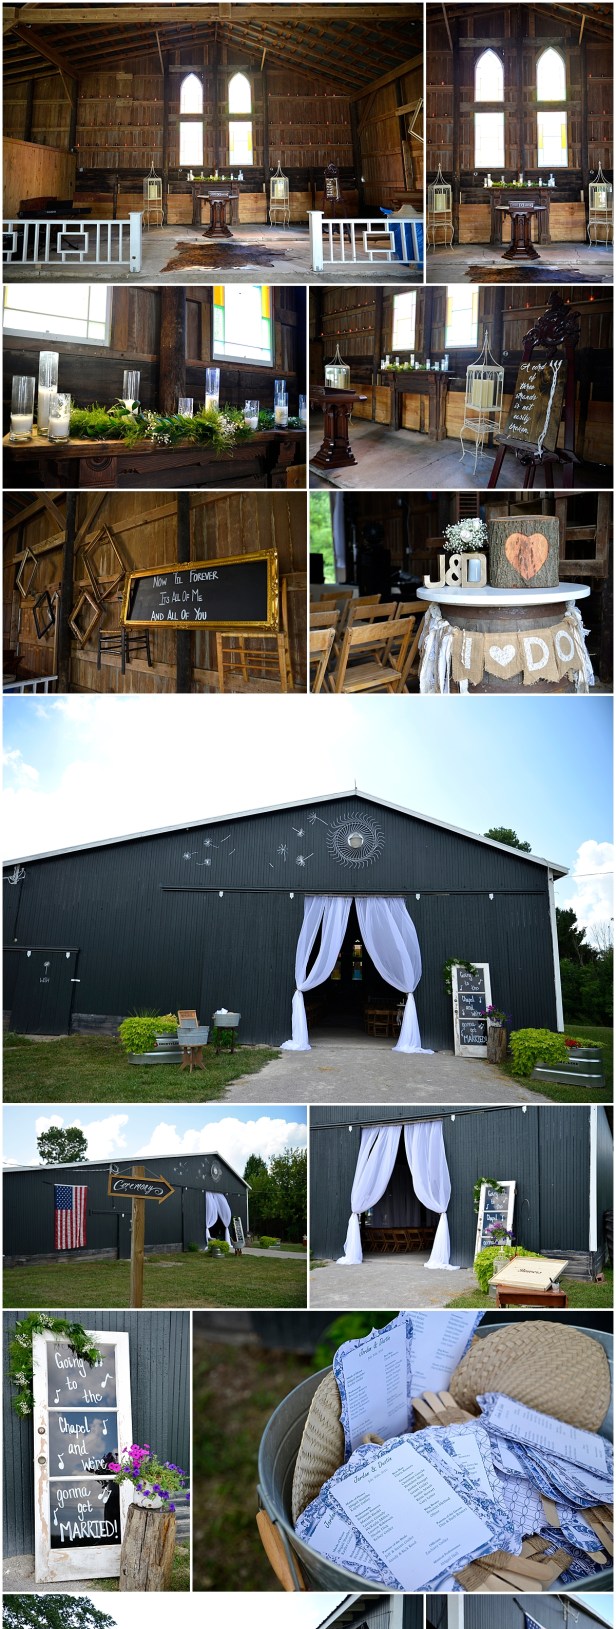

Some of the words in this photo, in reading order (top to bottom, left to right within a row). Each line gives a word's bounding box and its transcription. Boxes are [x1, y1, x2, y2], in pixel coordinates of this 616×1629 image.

[523, 630, 574, 672] DO
[113, 1180, 164, 1196] Ceremony
[55, 1352, 84, 1377] Going
[66, 1376, 78, 1390] to
[82, 1390, 102, 1403] the
[58, 1416, 90, 1439] Chapel
[68, 1443, 88, 1455] and
[354, 1472, 370, 1484] Jordan
[56, 1487, 91, 1508] gonna
[78, 1502, 93, 1521] get
[60, 1520, 118, 1542] MARRIED!
